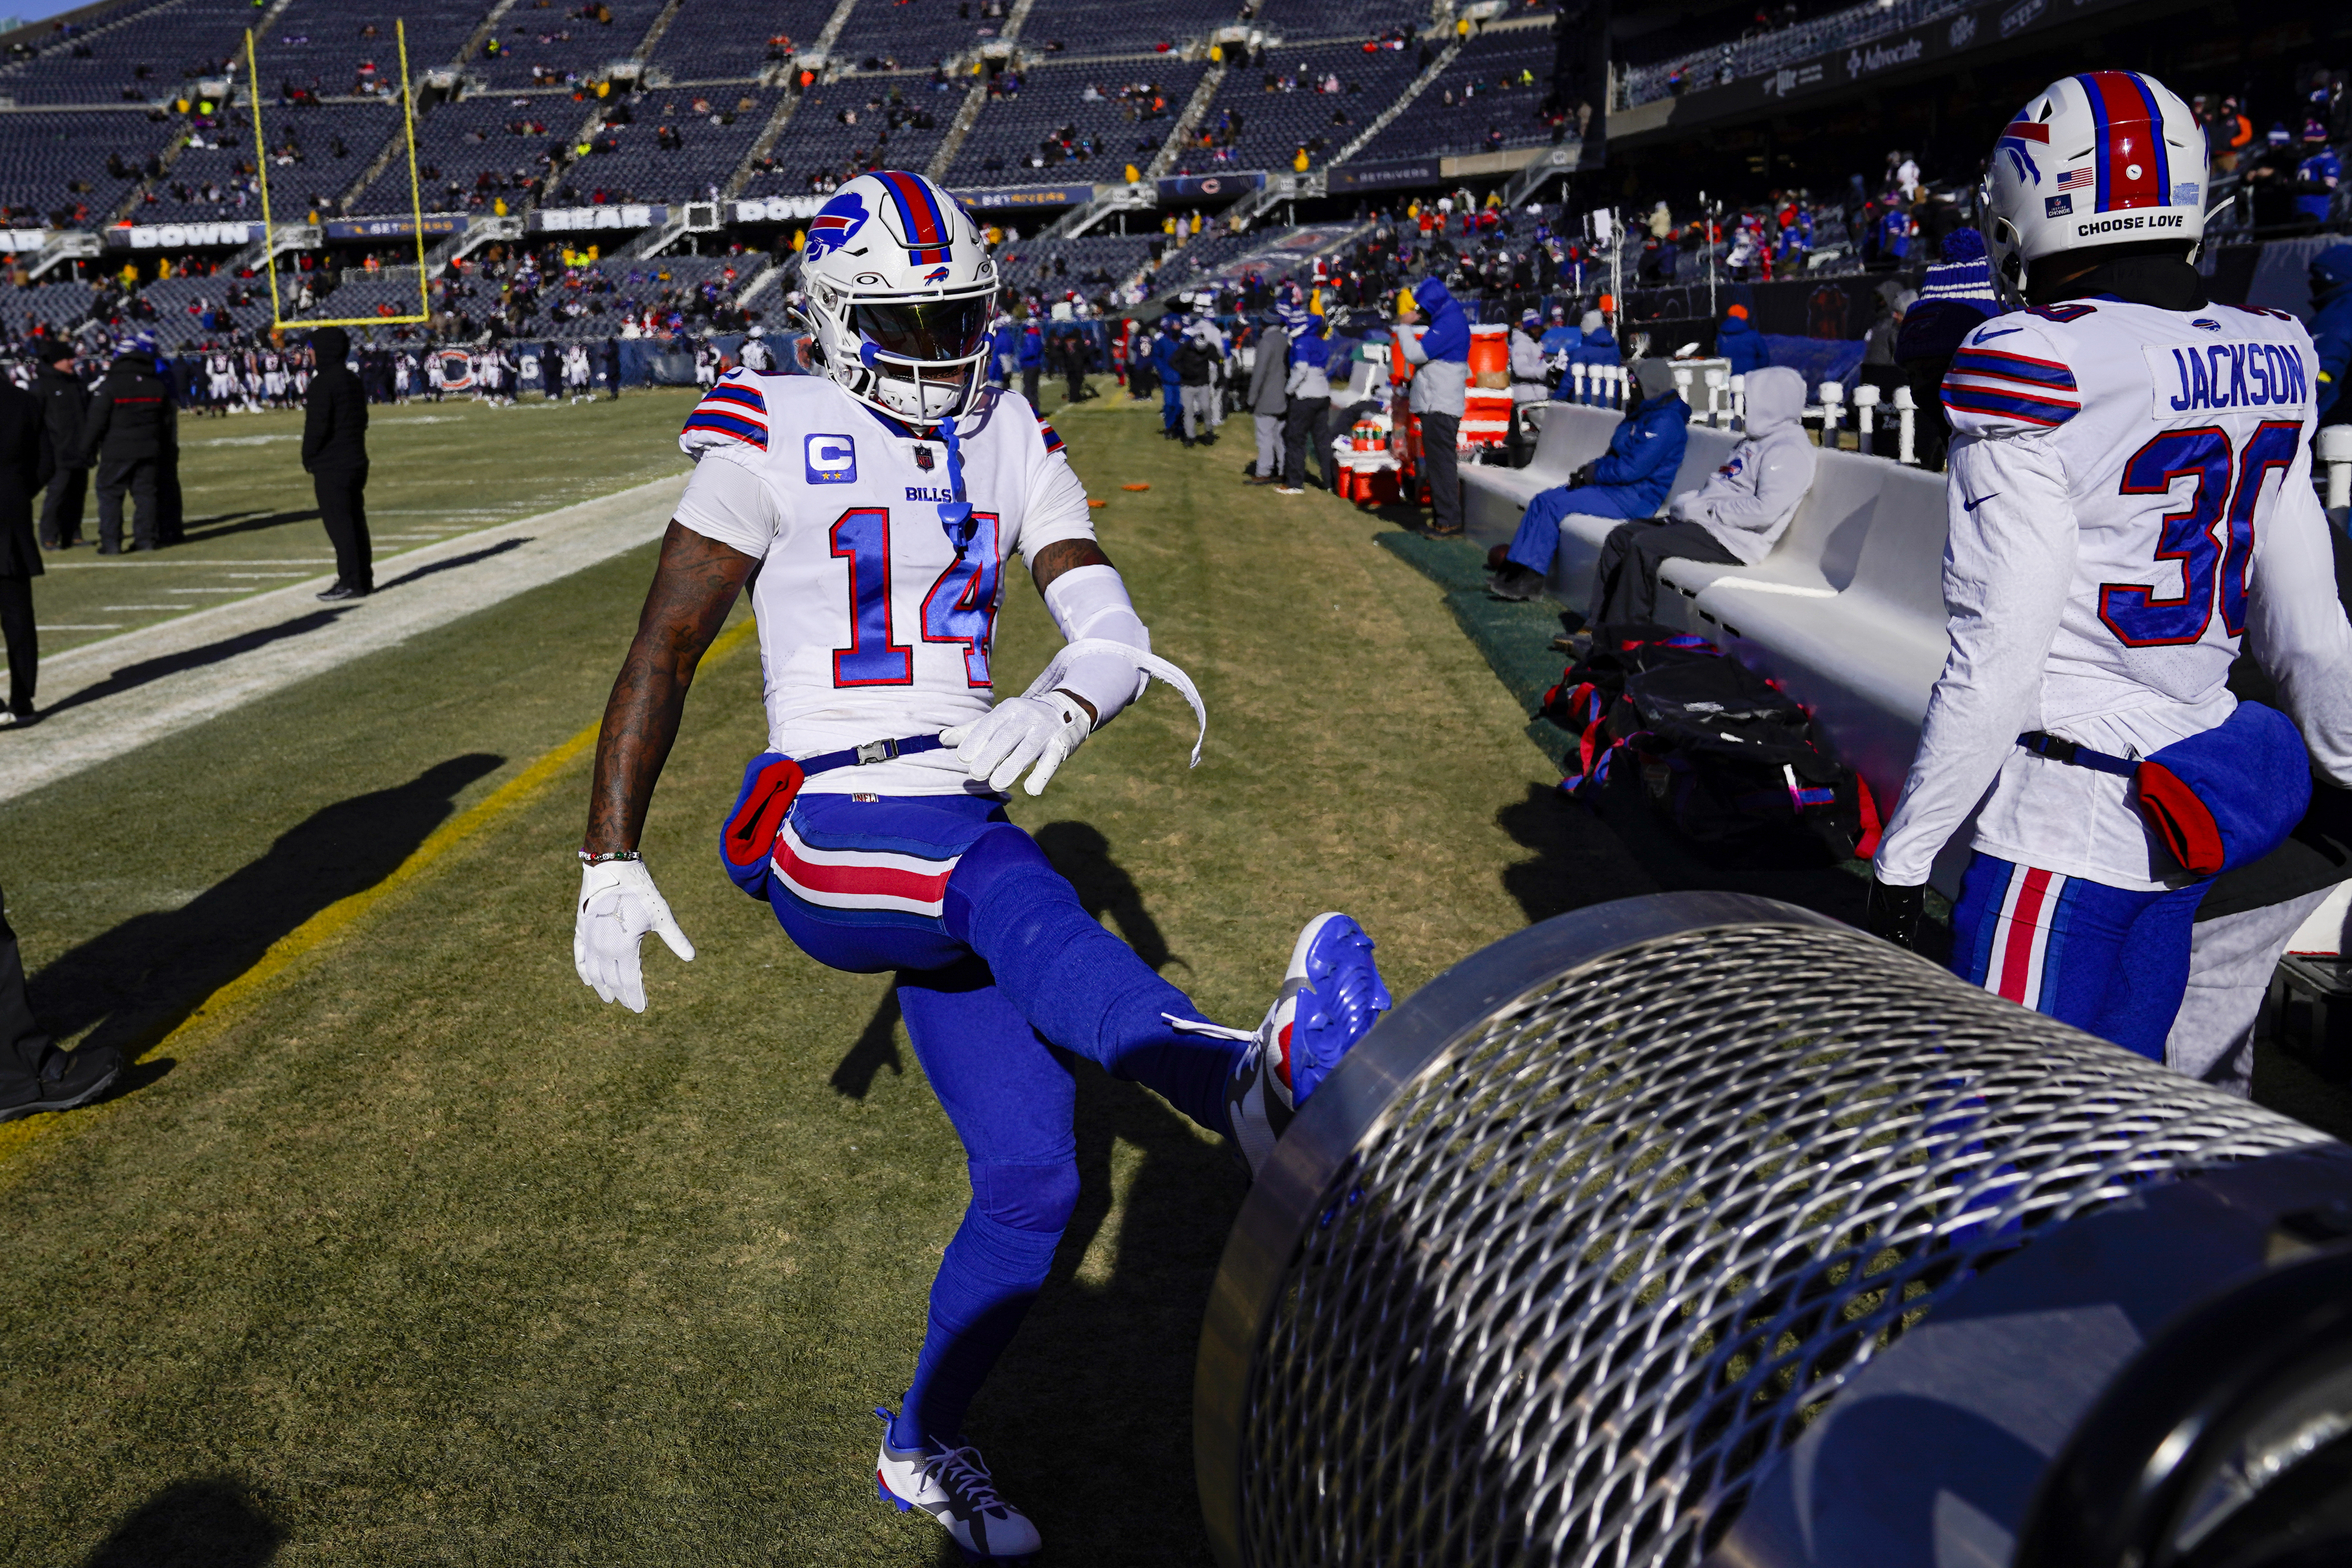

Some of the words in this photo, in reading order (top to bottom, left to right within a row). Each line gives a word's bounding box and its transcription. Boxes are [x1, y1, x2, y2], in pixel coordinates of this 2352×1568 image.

[542, 207, 652, 231] BEAR
[736, 197, 831, 223] DOW
[2048, 208, 2070, 216] CHANGE
[130, 225, 249, 248] DOWN
[370, 221, 453, 235] BETRIERS
[2078, 216, 2144, 236] CHOOSE
[2149, 215, 2183, 228] LOVE
[2170, 343, 2307, 412] JACKSON
[808, 436, 852, 471] C
[917, 455, 933, 467] NFL
[905, 487, 952, 502] BILLS
[2097, 420, 2304, 648] 30
[829, 507, 999, 689] 14
[856, 793, 875, 803] NFL
